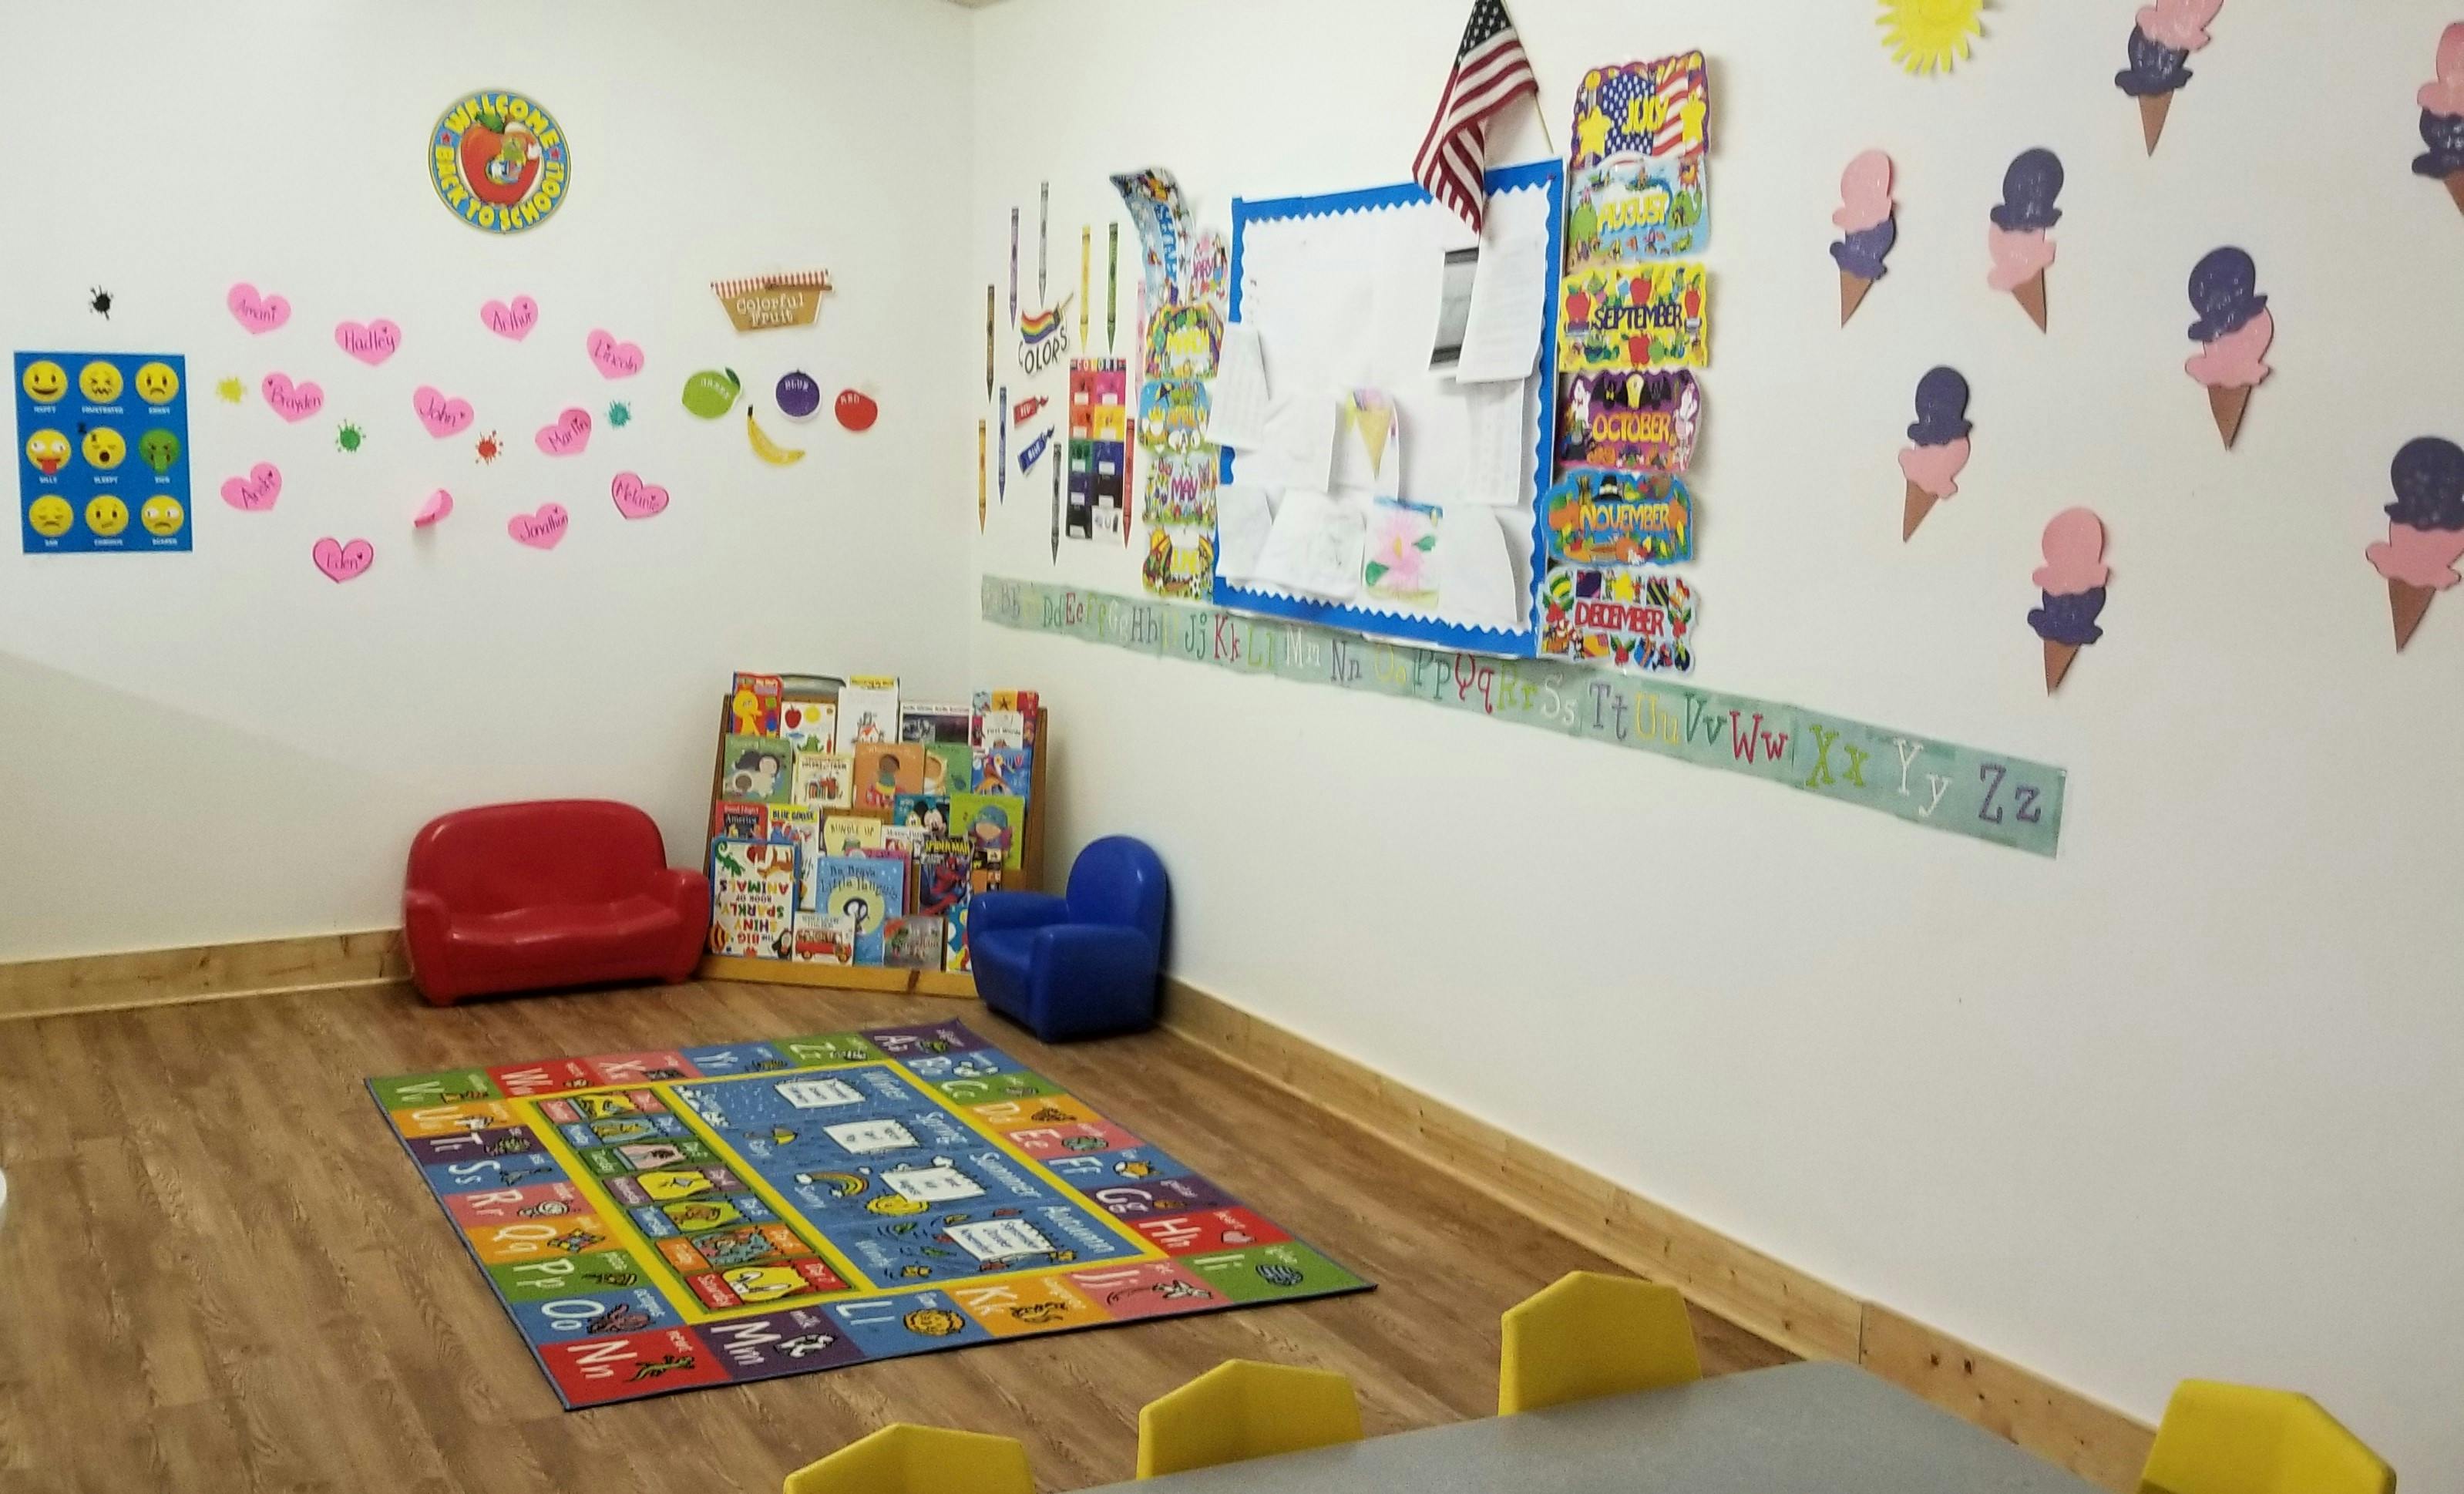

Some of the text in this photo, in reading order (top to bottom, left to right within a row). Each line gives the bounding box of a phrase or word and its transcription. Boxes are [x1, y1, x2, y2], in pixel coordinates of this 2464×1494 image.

[444, 93, 560, 149] WELCOME
[1622, 94, 1669, 136] JULY
[435, 146, 469, 208] BACK
[466, 199, 494, 227] TO
[1596, 190, 1669, 231] AUGUST
[737, 292, 804, 315] Colorful
[752, 309, 793, 326] Fruit
[1592, 304, 1683, 331] SEPTEMBER
[345, 330, 395, 353] Hadley
[1018, 326, 1067, 374] COLORS
[1592, 412, 1671, 443] OCTOBER
[1171, 476, 1198, 501] MAY
[1579, 503, 1670, 533] NOVEMBER
[1574, 600, 1665, 637] DECEMBER
[1044, 594, 1064, 628] Dd
[1066, 592, 1084, 625] Ee
[1131, 606, 1158, 643] Hh
[1185, 614, 1207, 660] Jj
[1214, 614, 1240, 662] Kk
[1330, 639, 1363, 684] Nn
[1454, 652, 1494, 715] Qq
[1498, 661, 1538, 712] Rr
[1543, 671, 1578, 725] Ss
[1589, 682, 1628, 741] Tt
[1635, 691, 1679, 746] Uu
[1684, 691, 1727, 746] Vv
[1730, 709, 1789, 765] Ww
[1807, 724, 1870, 788] Xx
[1893, 737, 1952, 817] Yy
[1978, 763, 2042, 824] Zz
[720, 879, 790, 896] ANIMALS
[721, 903, 785, 919] SPARKLY
[734, 917, 778, 933] SHINY
[737, 932, 760, 944] BIG
[424, 1131, 487, 1152] Tt
[1005, 1127, 1075, 1150] Ee
[444, 1159, 510, 1185] Ss
[1044, 1155, 1114, 1176] Ff
[463, 1189, 534, 1218] Rr
[1084, 1185, 1172, 1215] Gg
[479, 1221, 568, 1257] Qq
[1134, 1216, 1221, 1248] Hh
[505, 1258, 587, 1292] Pp
[1189, 1253, 1257, 1271] Ii
[1067, 1266, 1153, 1291] Jj
[536, 1295, 617, 1332] Oo
[833, 1298, 909, 1326] Ll
[953, 1284, 1035, 1317] Kk
[707, 1320, 800, 1367] Mm
[564, 1338, 650, 1381] Nn
